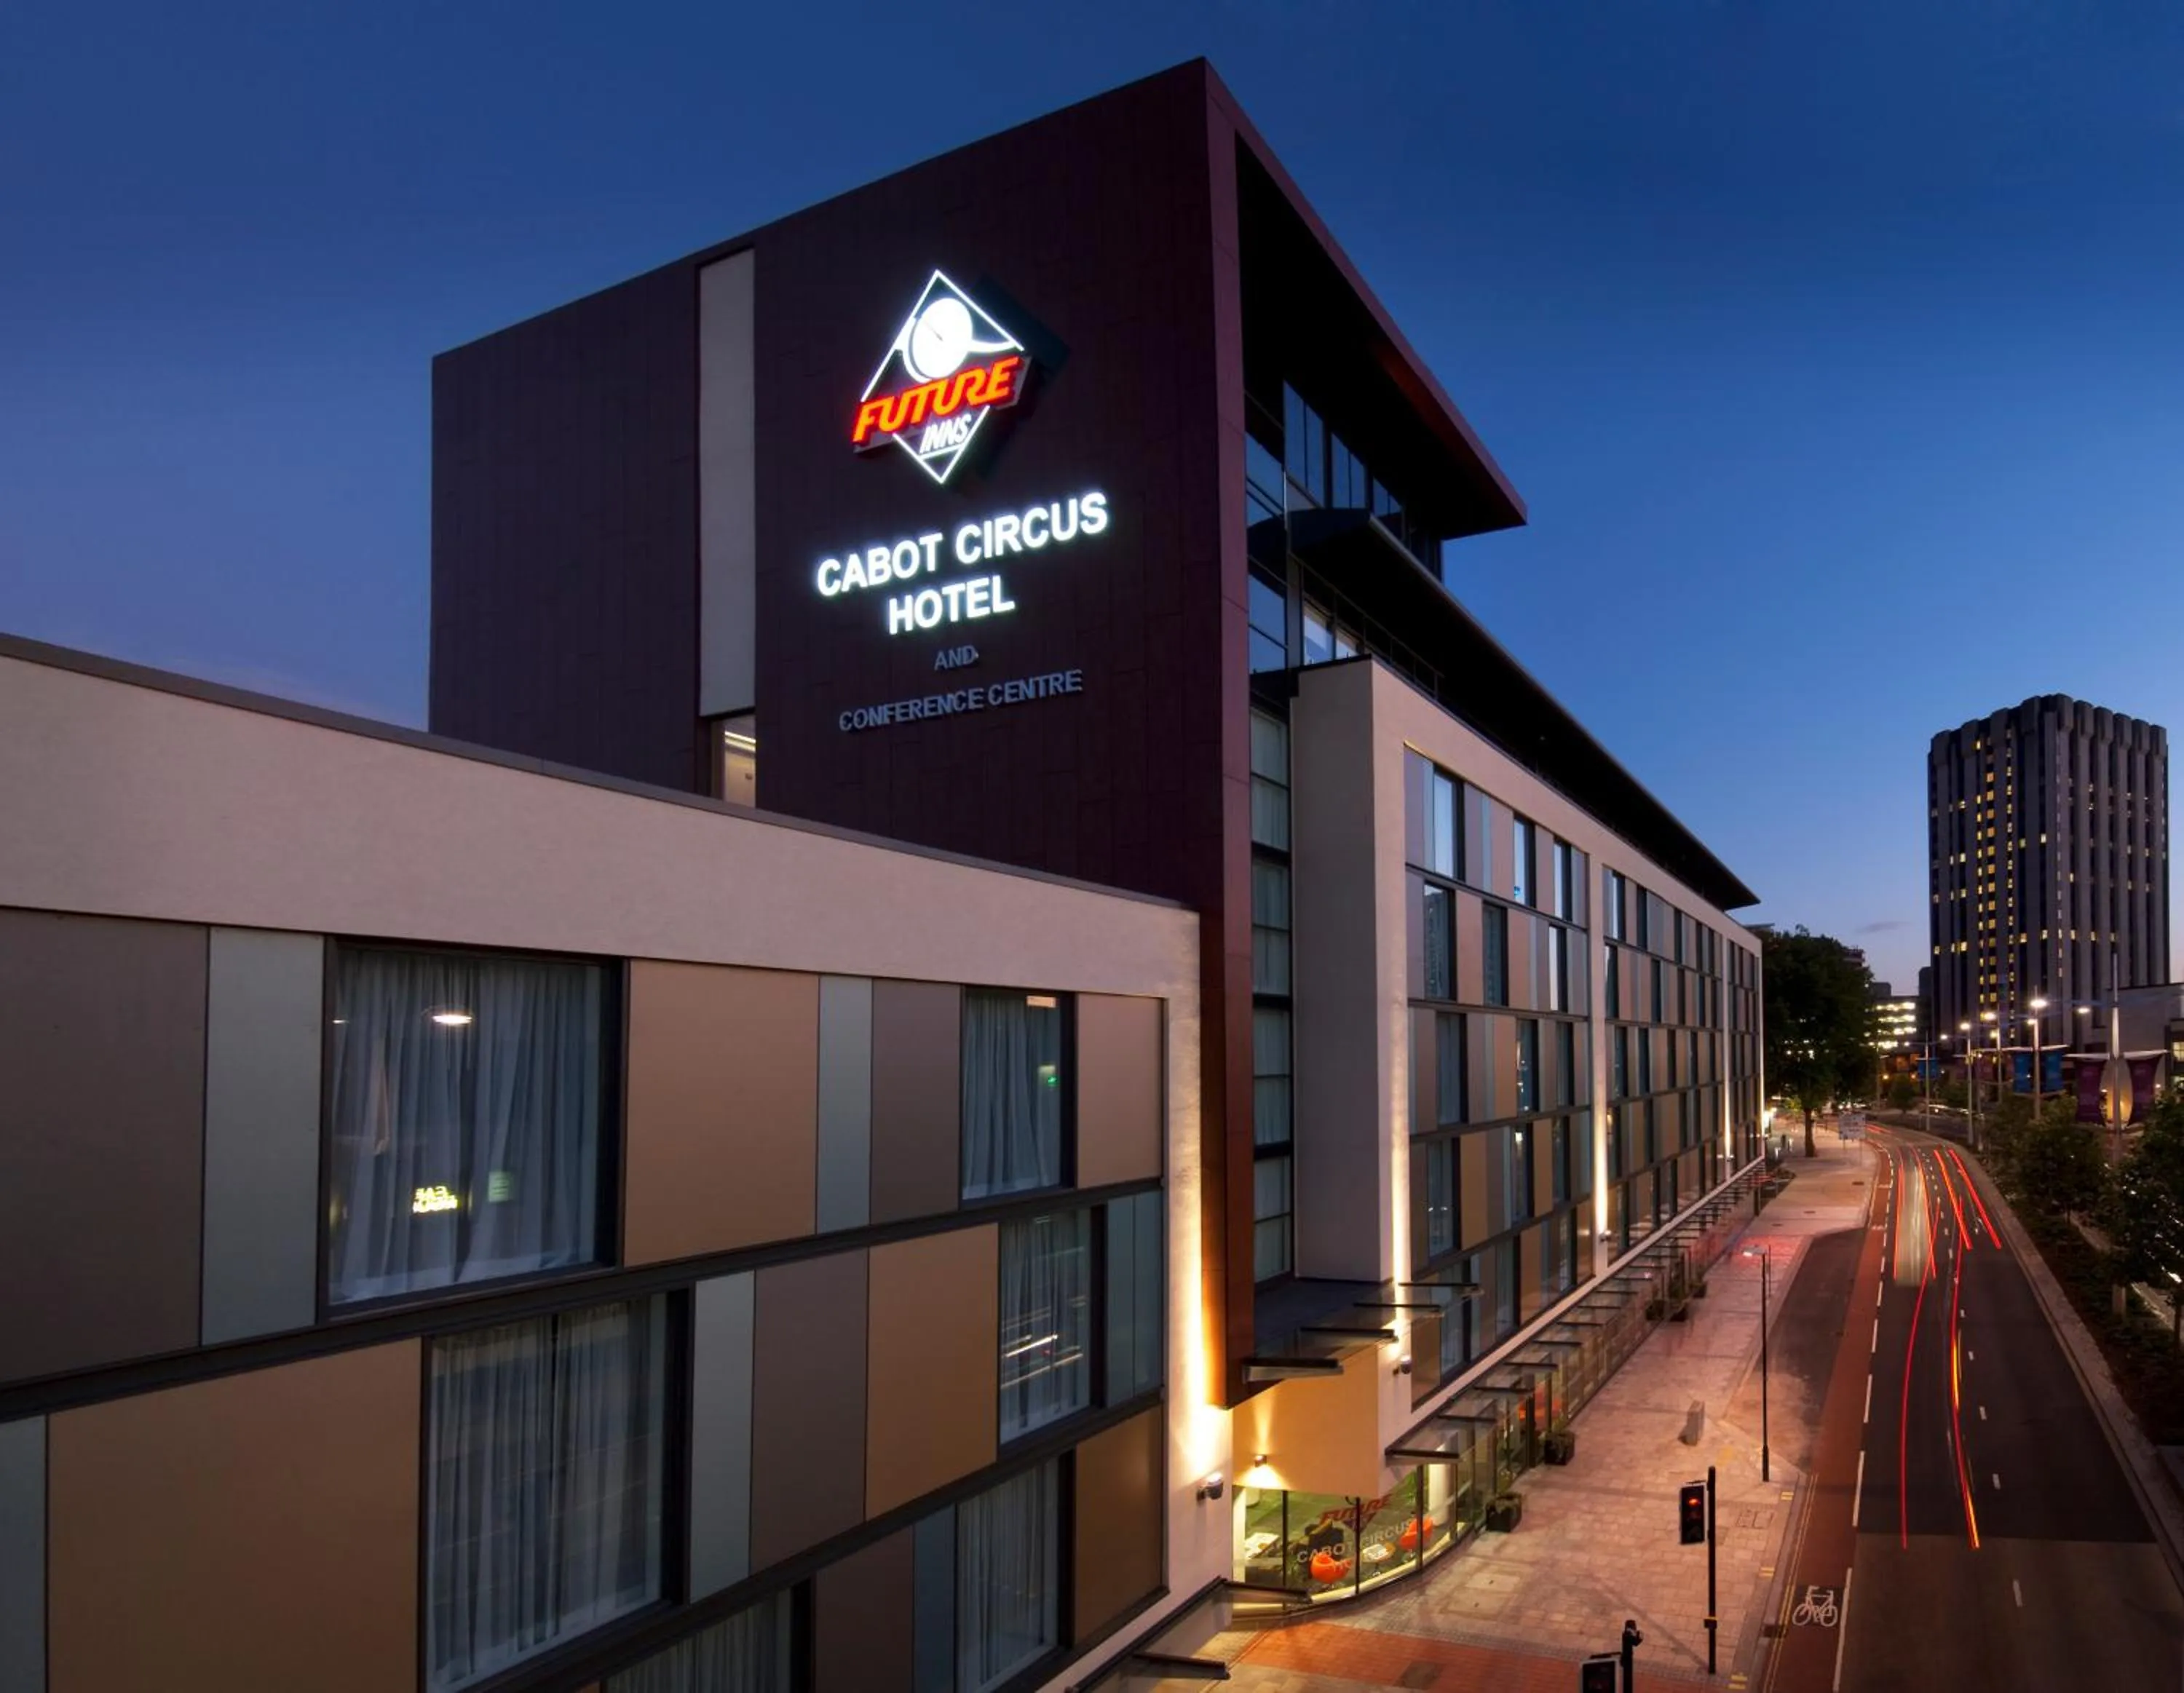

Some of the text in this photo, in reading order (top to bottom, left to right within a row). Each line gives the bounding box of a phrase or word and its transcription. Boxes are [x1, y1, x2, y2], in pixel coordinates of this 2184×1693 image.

[852, 356, 1019, 443] FUTURE
[919, 413, 972, 453] INNS
[816, 491, 1108, 597] CABOT CIRCUS
[887, 575, 1016, 635] HOTEL
[934, 645, 979, 671] AND
[839, 669, 1083, 731] CONFERENCE CENTRE
